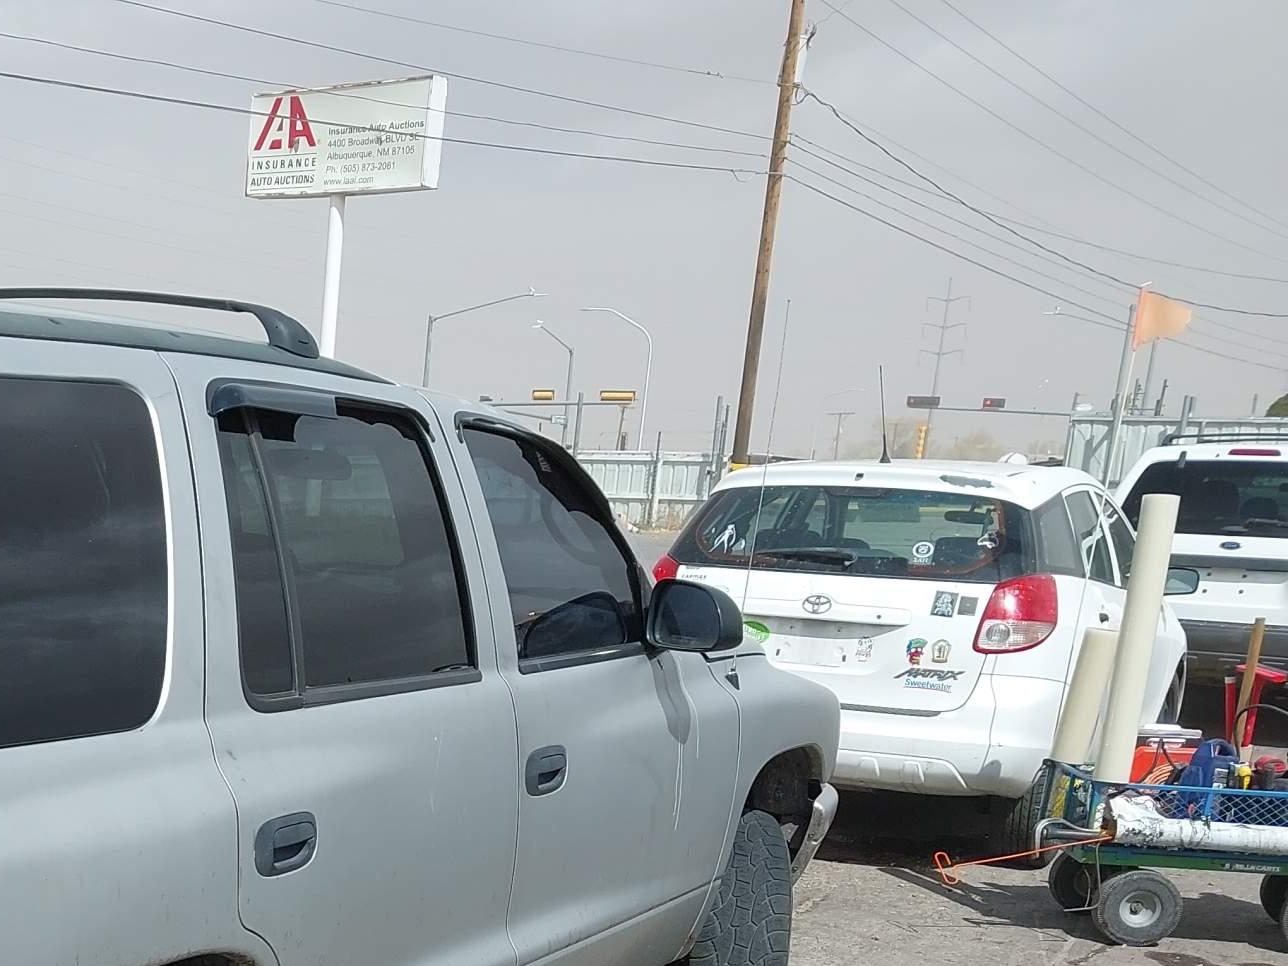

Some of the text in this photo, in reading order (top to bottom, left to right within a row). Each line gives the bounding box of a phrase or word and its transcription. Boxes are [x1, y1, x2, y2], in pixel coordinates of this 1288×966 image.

[389, 120, 425, 130] Auctions
[327, 138, 346, 148] 4400
[347, 136, 383, 146] Broadway
[385, 133, 407, 143] BLVD
[376, 147, 390, 157] NM
[251, 157, 317, 170] INSURANCE
[250, 174, 315, 187] AUTO AUCTIONS
[893, 667, 966, 682] MATRIX
[904, 678, 952, 692] Sweetwater
